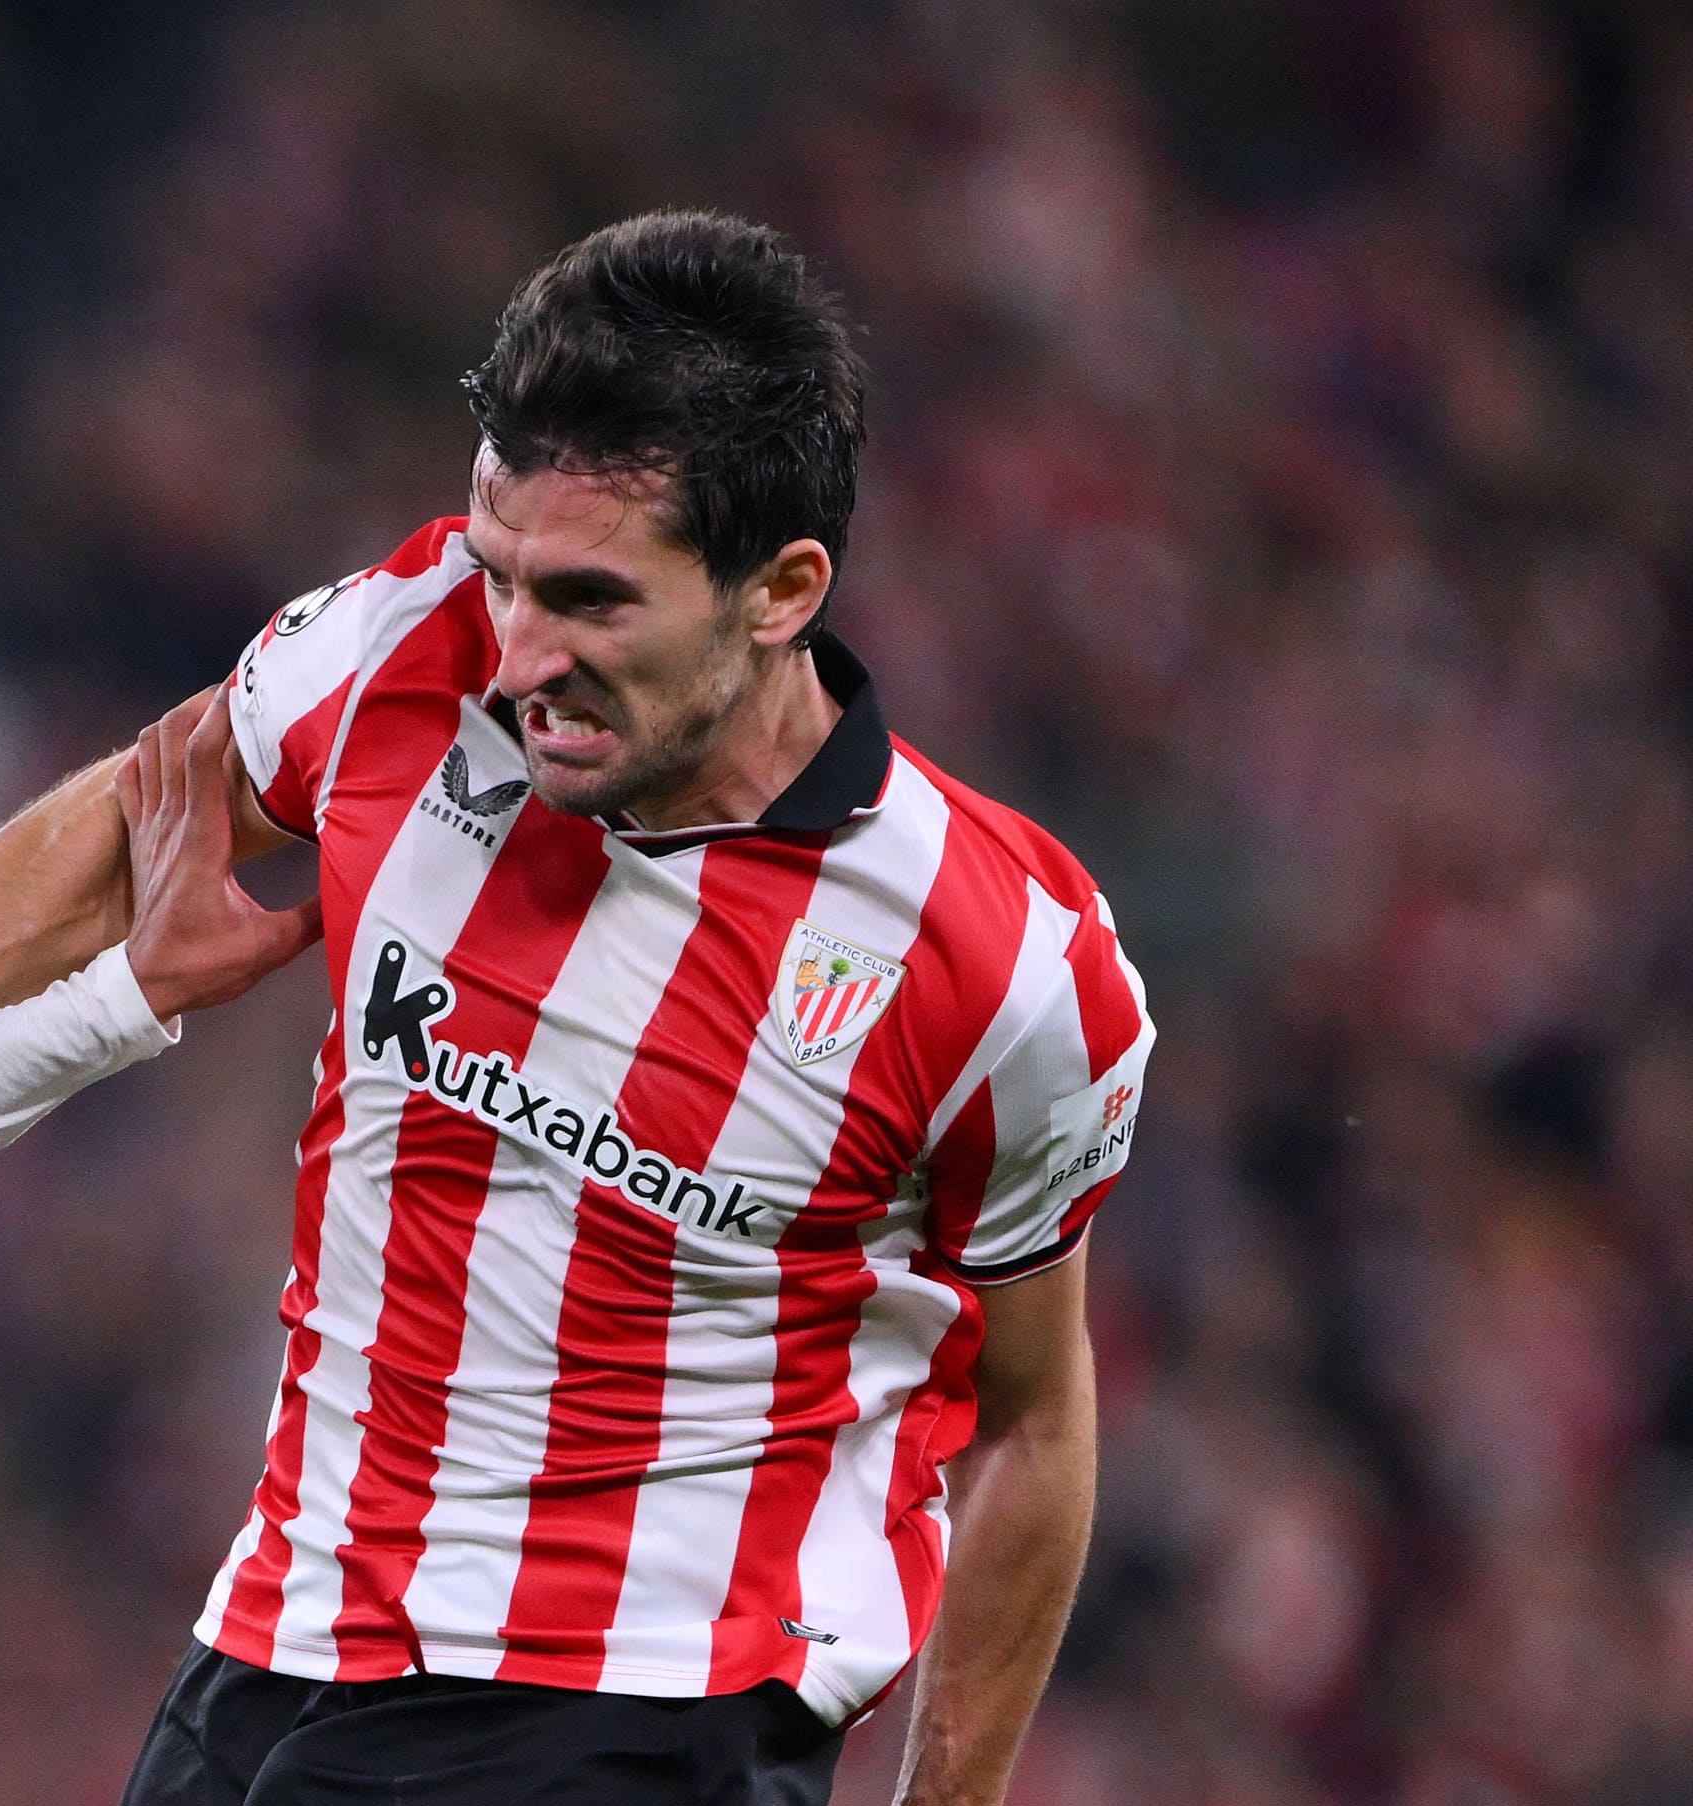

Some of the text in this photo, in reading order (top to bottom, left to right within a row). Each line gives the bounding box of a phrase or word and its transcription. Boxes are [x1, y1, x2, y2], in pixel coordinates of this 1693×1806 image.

[420, 797, 496, 848] CASTORE
[800, 928, 897, 978] ATHLETIC CLUB
[787, 1019, 837, 1061] BILBAO
[363, 940, 769, 1238] Kutxabank
